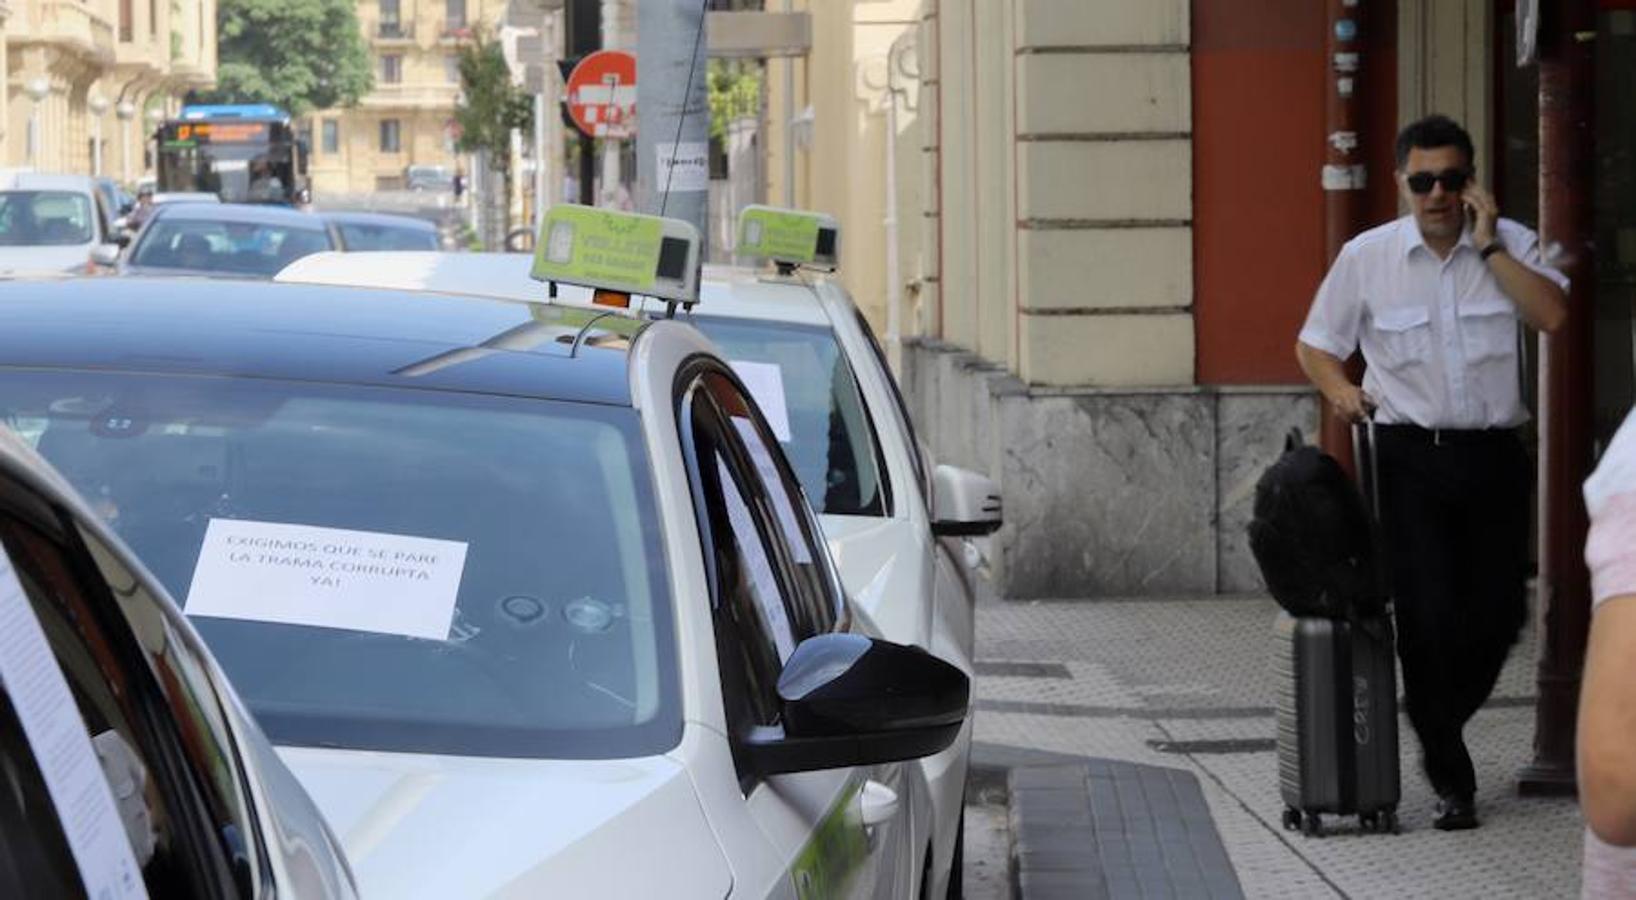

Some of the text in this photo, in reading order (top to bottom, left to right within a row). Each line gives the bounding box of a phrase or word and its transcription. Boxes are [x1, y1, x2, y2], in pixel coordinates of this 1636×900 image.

[225, 536, 438, 564] EXIGIMOS QUE SE PARE
[229, 551, 430, 580] LA TRAMA CORRUPTA
